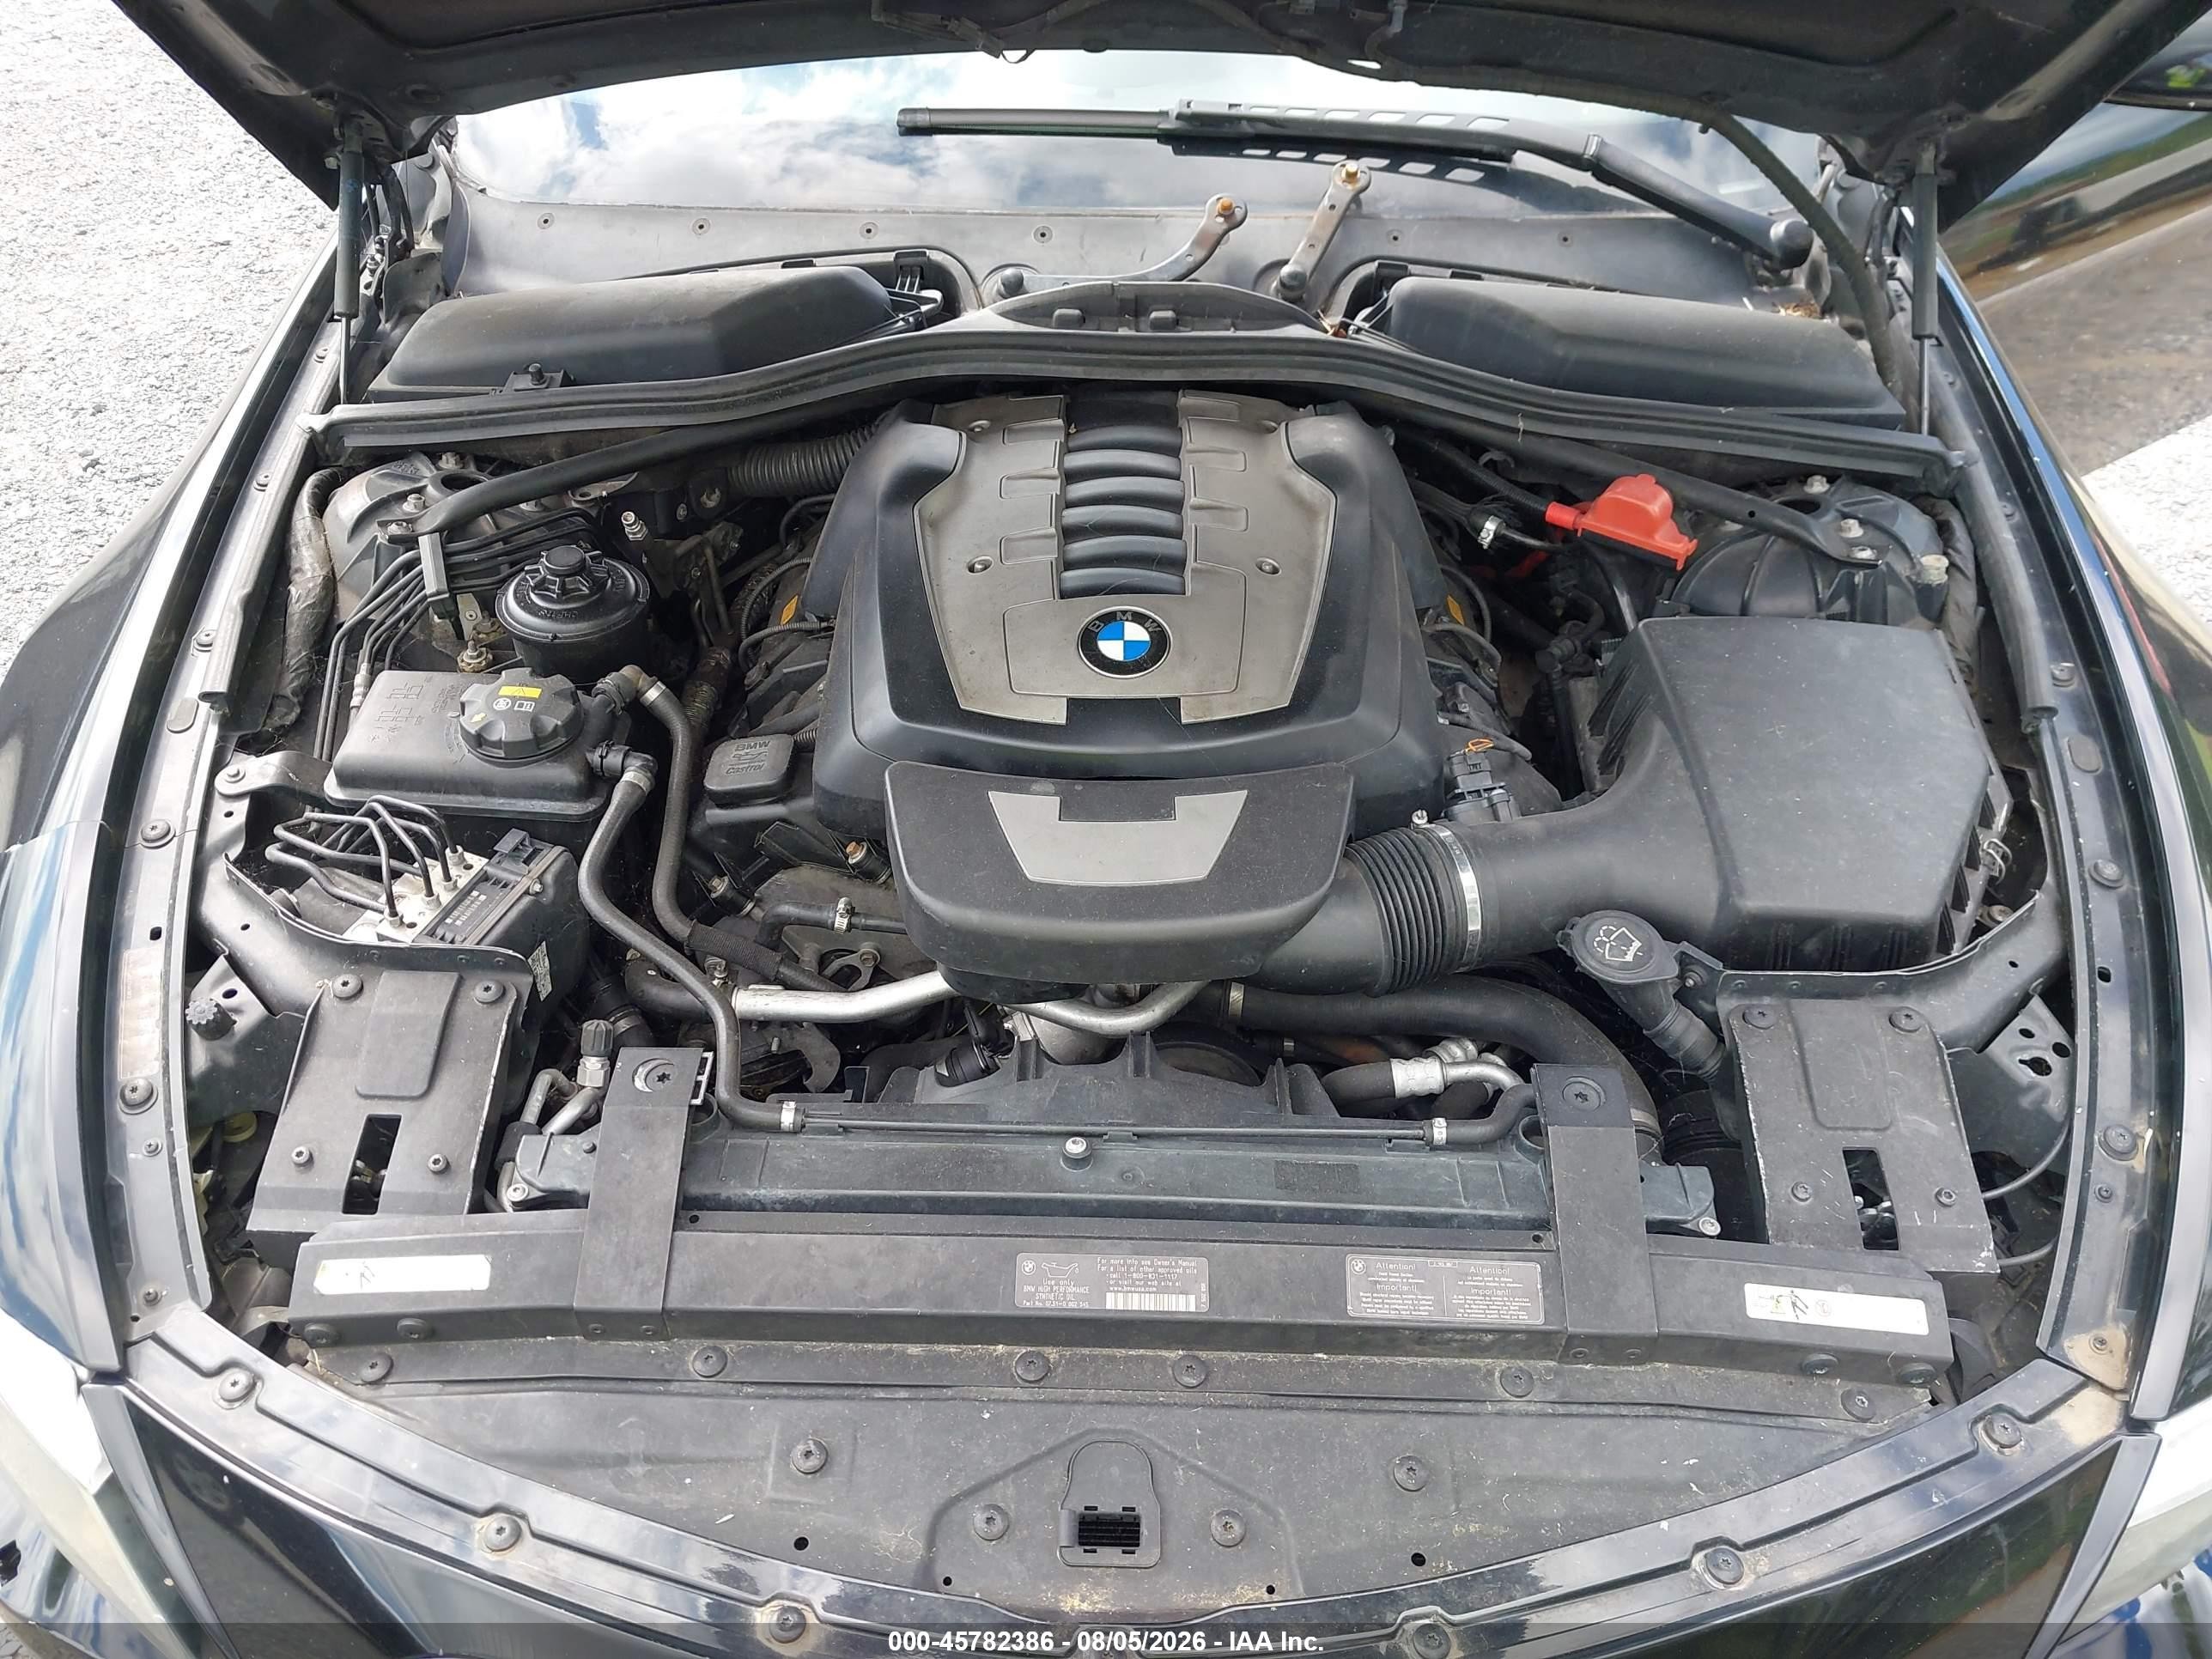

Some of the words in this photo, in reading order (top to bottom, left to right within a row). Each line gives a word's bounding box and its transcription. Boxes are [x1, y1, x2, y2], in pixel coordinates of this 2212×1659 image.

[1087, 611, 1162, 633] BMW
[735, 740, 770, 750] BMW
[726, 763, 765, 775] Castrol
[1153, 1257, 1176, 1266] Owner's
[1177, 1258, 1197, 1267] Manual
[1376, 1262, 1416, 1271] Attention!
[1130, 1264, 1137, 1273] of
[1158, 1266, 1183, 1274] approved
[1185, 1267, 1197, 1275] oils
[1469, 1266, 1510, 1275] Attention!
[1042, 1277, 1055, 1285] Use
[1059, 1278, 1074, 1288] only
[1376, 1283, 1417, 1292] Important!
[1037, 1285, 1051, 1293] HIGH
[1053, 1285, 1091, 1294] PERFORMANCE
[1471, 1287, 1511, 1297] Important!
[1036, 1292, 1064, 1301] SYNTHETIC
